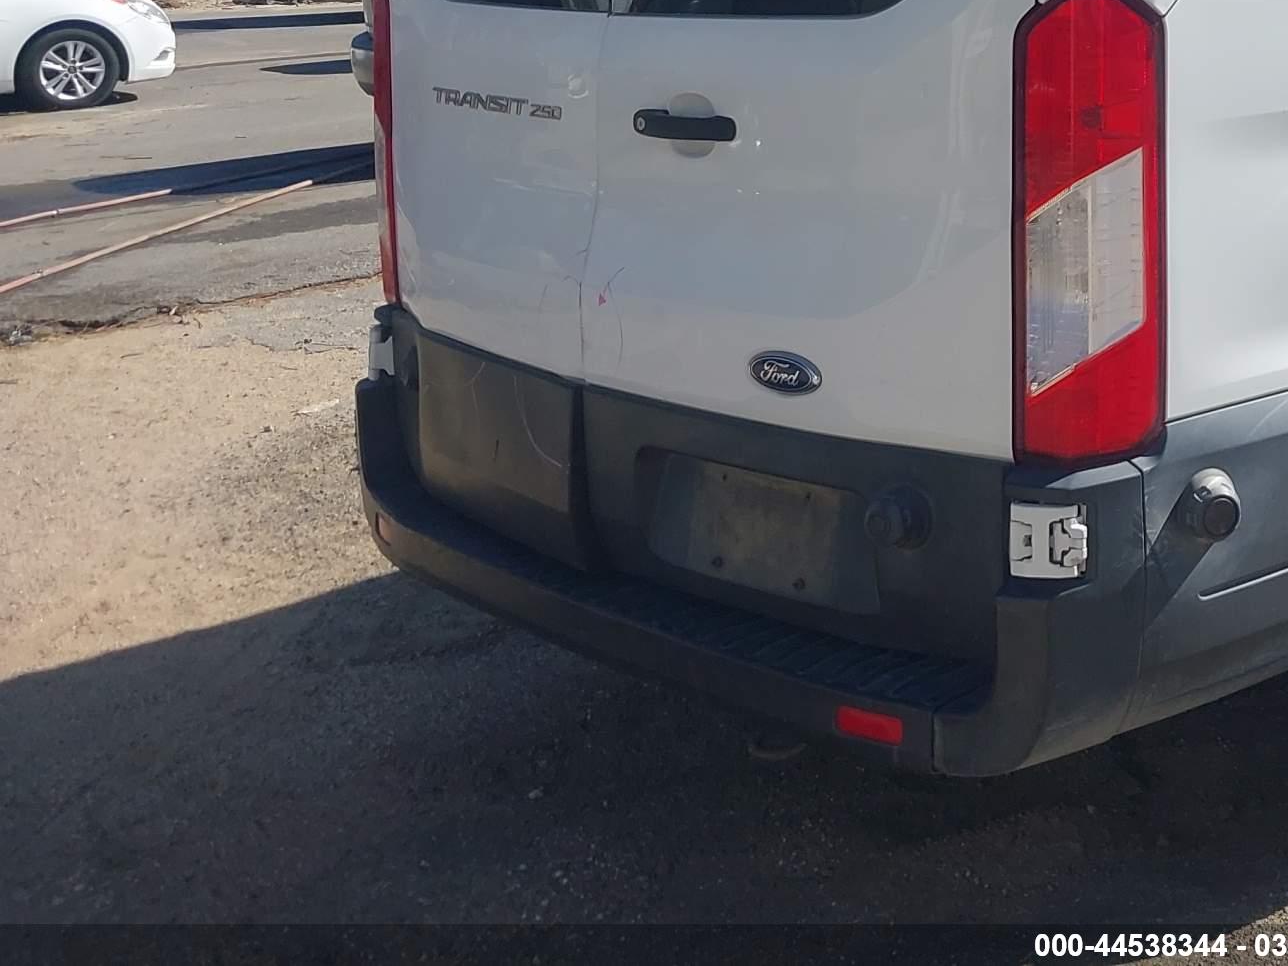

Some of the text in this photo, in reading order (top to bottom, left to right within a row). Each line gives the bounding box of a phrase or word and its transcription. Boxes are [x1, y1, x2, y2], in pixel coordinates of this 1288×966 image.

[432, 86, 563, 121] TRANSIT 250
[760, 360, 800, 387] Ford
